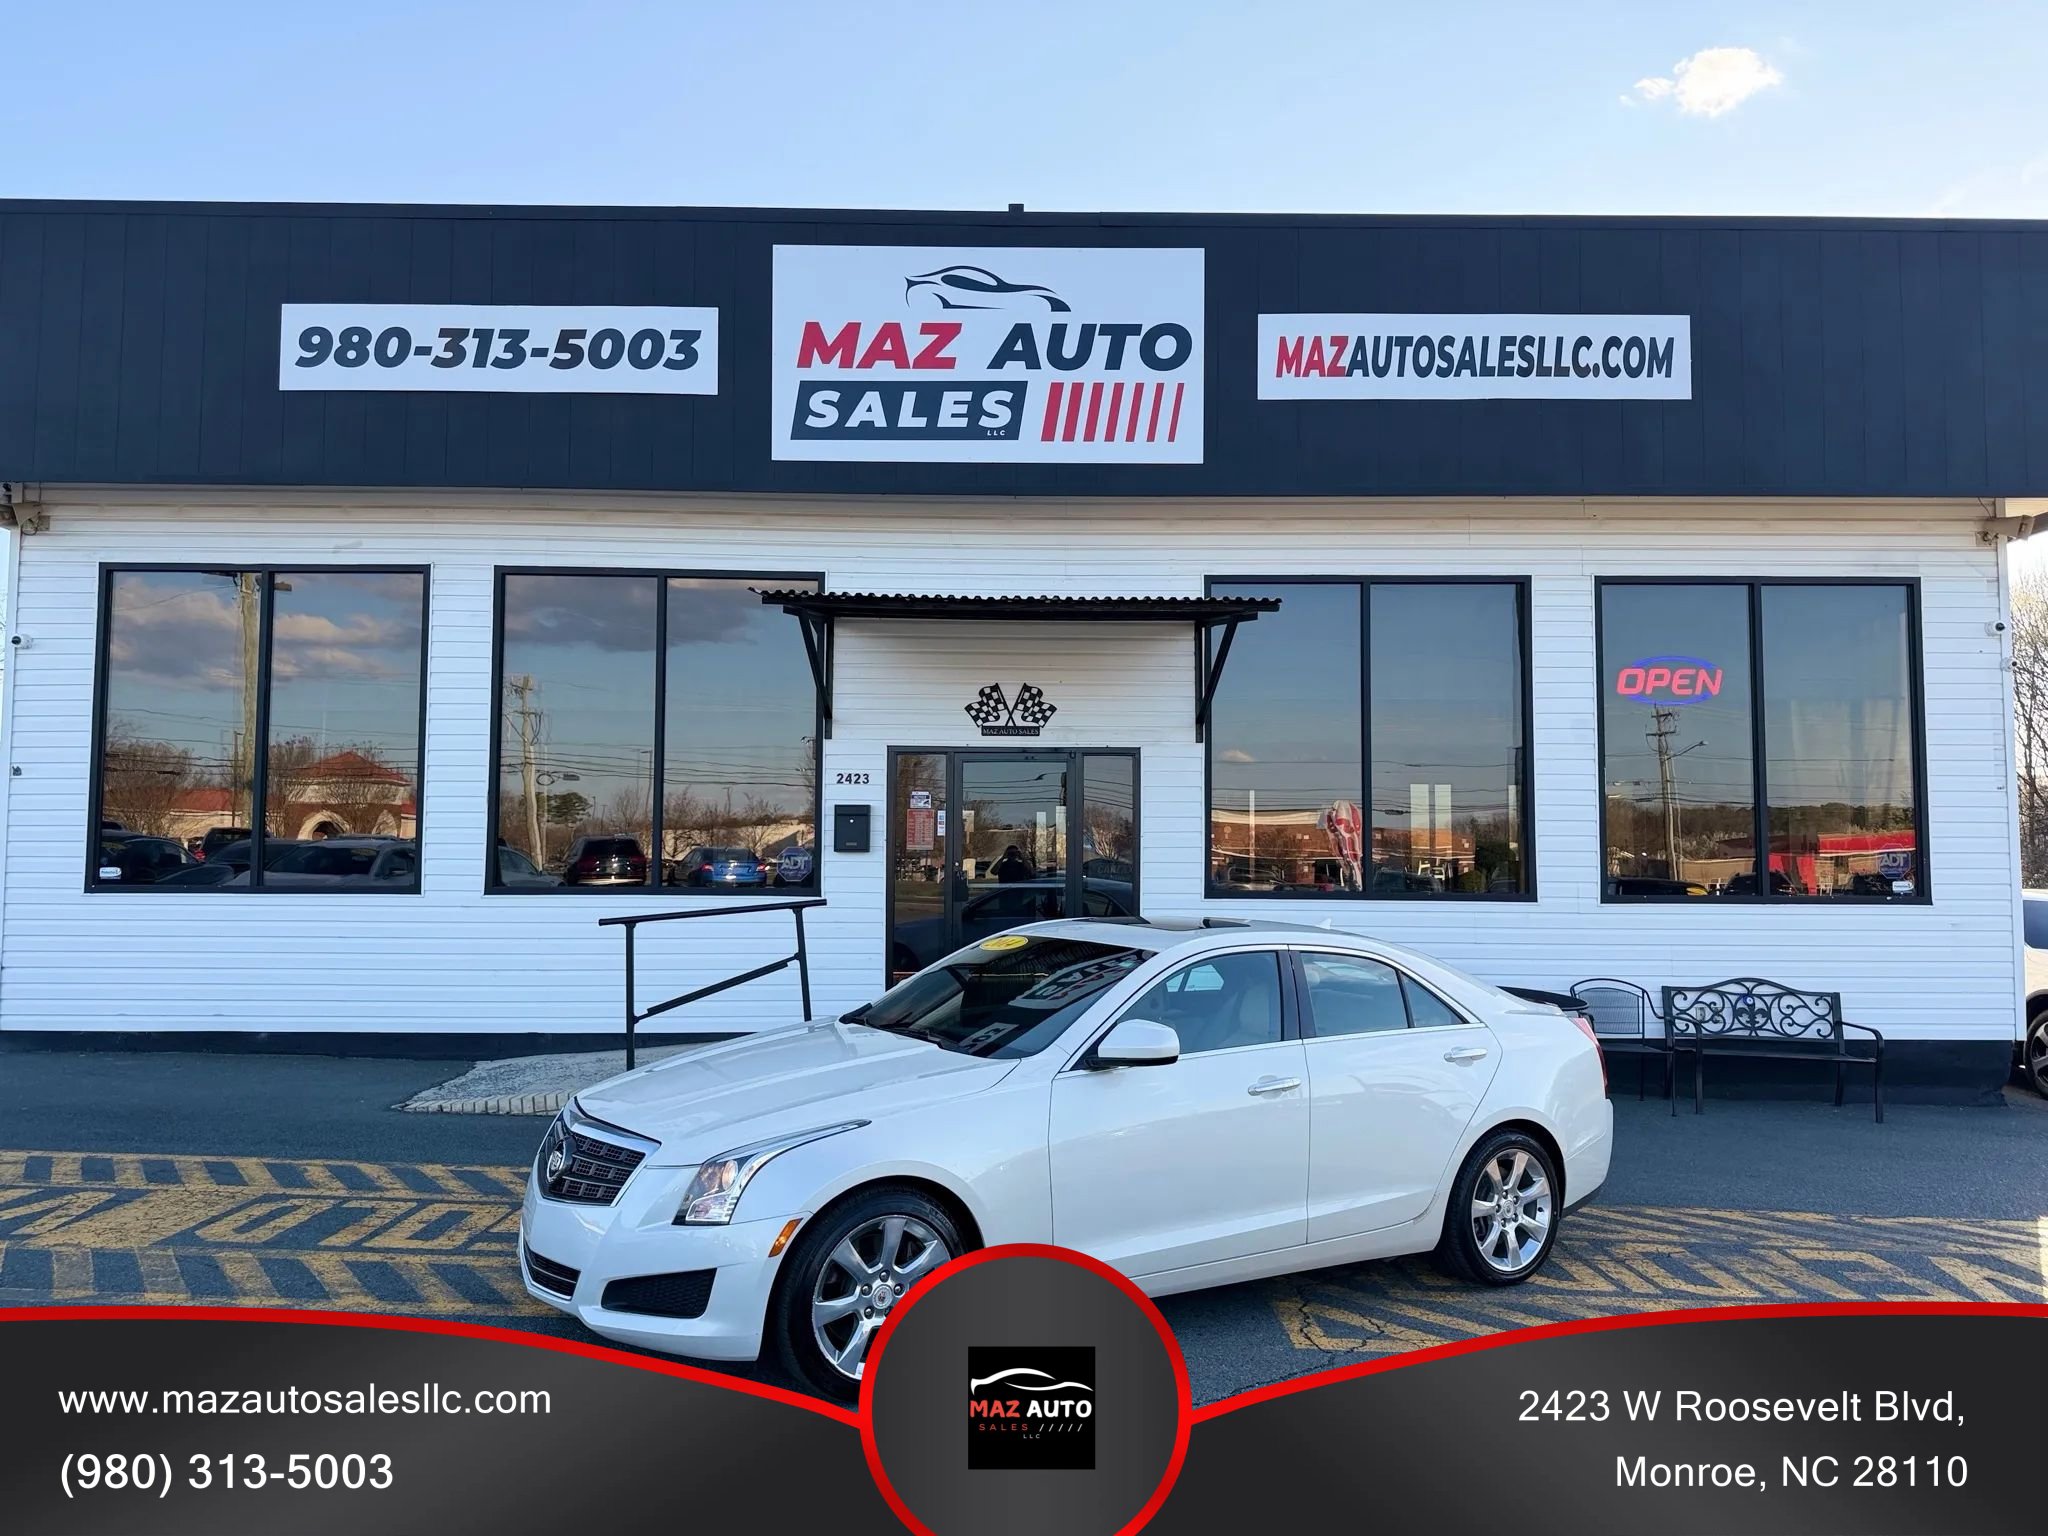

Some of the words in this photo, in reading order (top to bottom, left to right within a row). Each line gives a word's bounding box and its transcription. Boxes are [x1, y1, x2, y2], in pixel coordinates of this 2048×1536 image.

[295, 327, 702, 371] 980-313-5003
[797, 322, 963, 370] MAZ
[986, 323, 1193, 371] AUTO
[1276, 334, 1674, 379] MAZAUTOSALESLLC.COM
[805, 390, 1013, 429] SALES
[1616, 667, 1723, 696] OPEN
[836, 773, 870, 785] 2423
[782, 856, 808, 870] ADT
[1880, 853, 1907, 867] ADT
